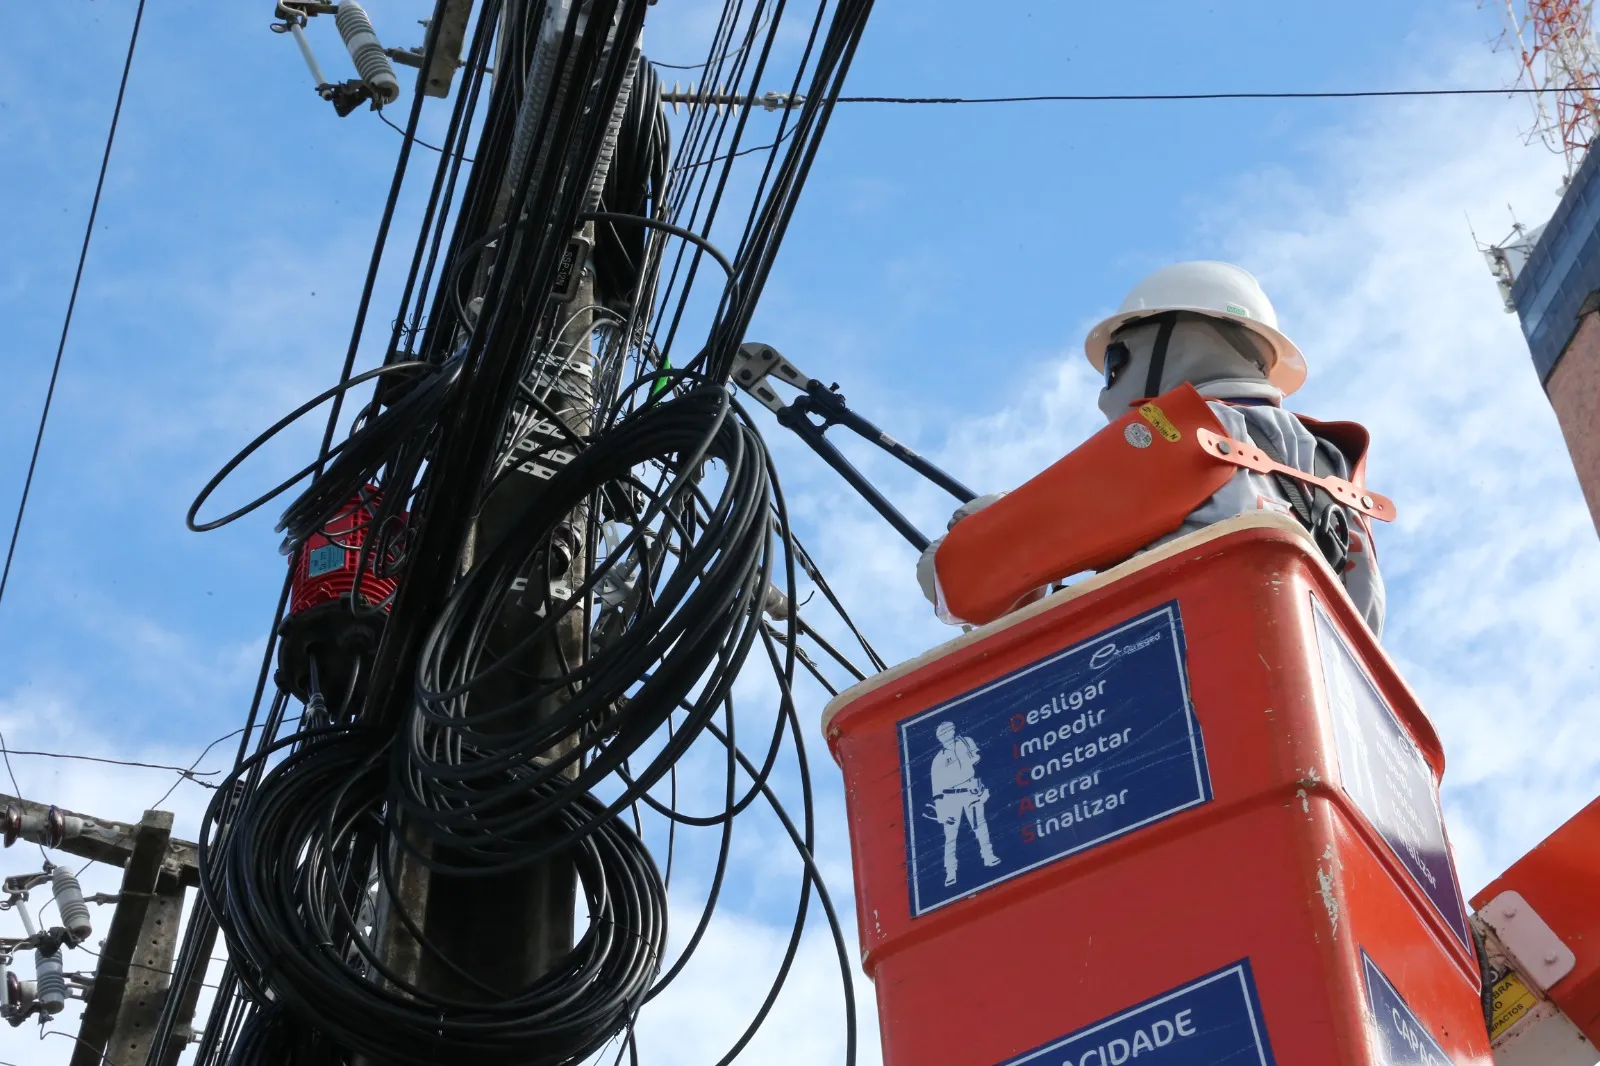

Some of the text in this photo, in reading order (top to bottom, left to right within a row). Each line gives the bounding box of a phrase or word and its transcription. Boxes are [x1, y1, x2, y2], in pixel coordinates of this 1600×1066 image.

[1009, 680, 1106, 732] Desligar
[1013, 709, 1105, 760] Impedir
[1015, 728, 1131, 786] Constatar
[1019, 770, 1101, 817] Aterrar
[1022, 789, 1128, 843] Sinalizar
[1492, 981, 1513, 1000] BRA
[1062, 1008, 1197, 1066] CIDADE
[1392, 1007, 1439, 1066] CAPAC
